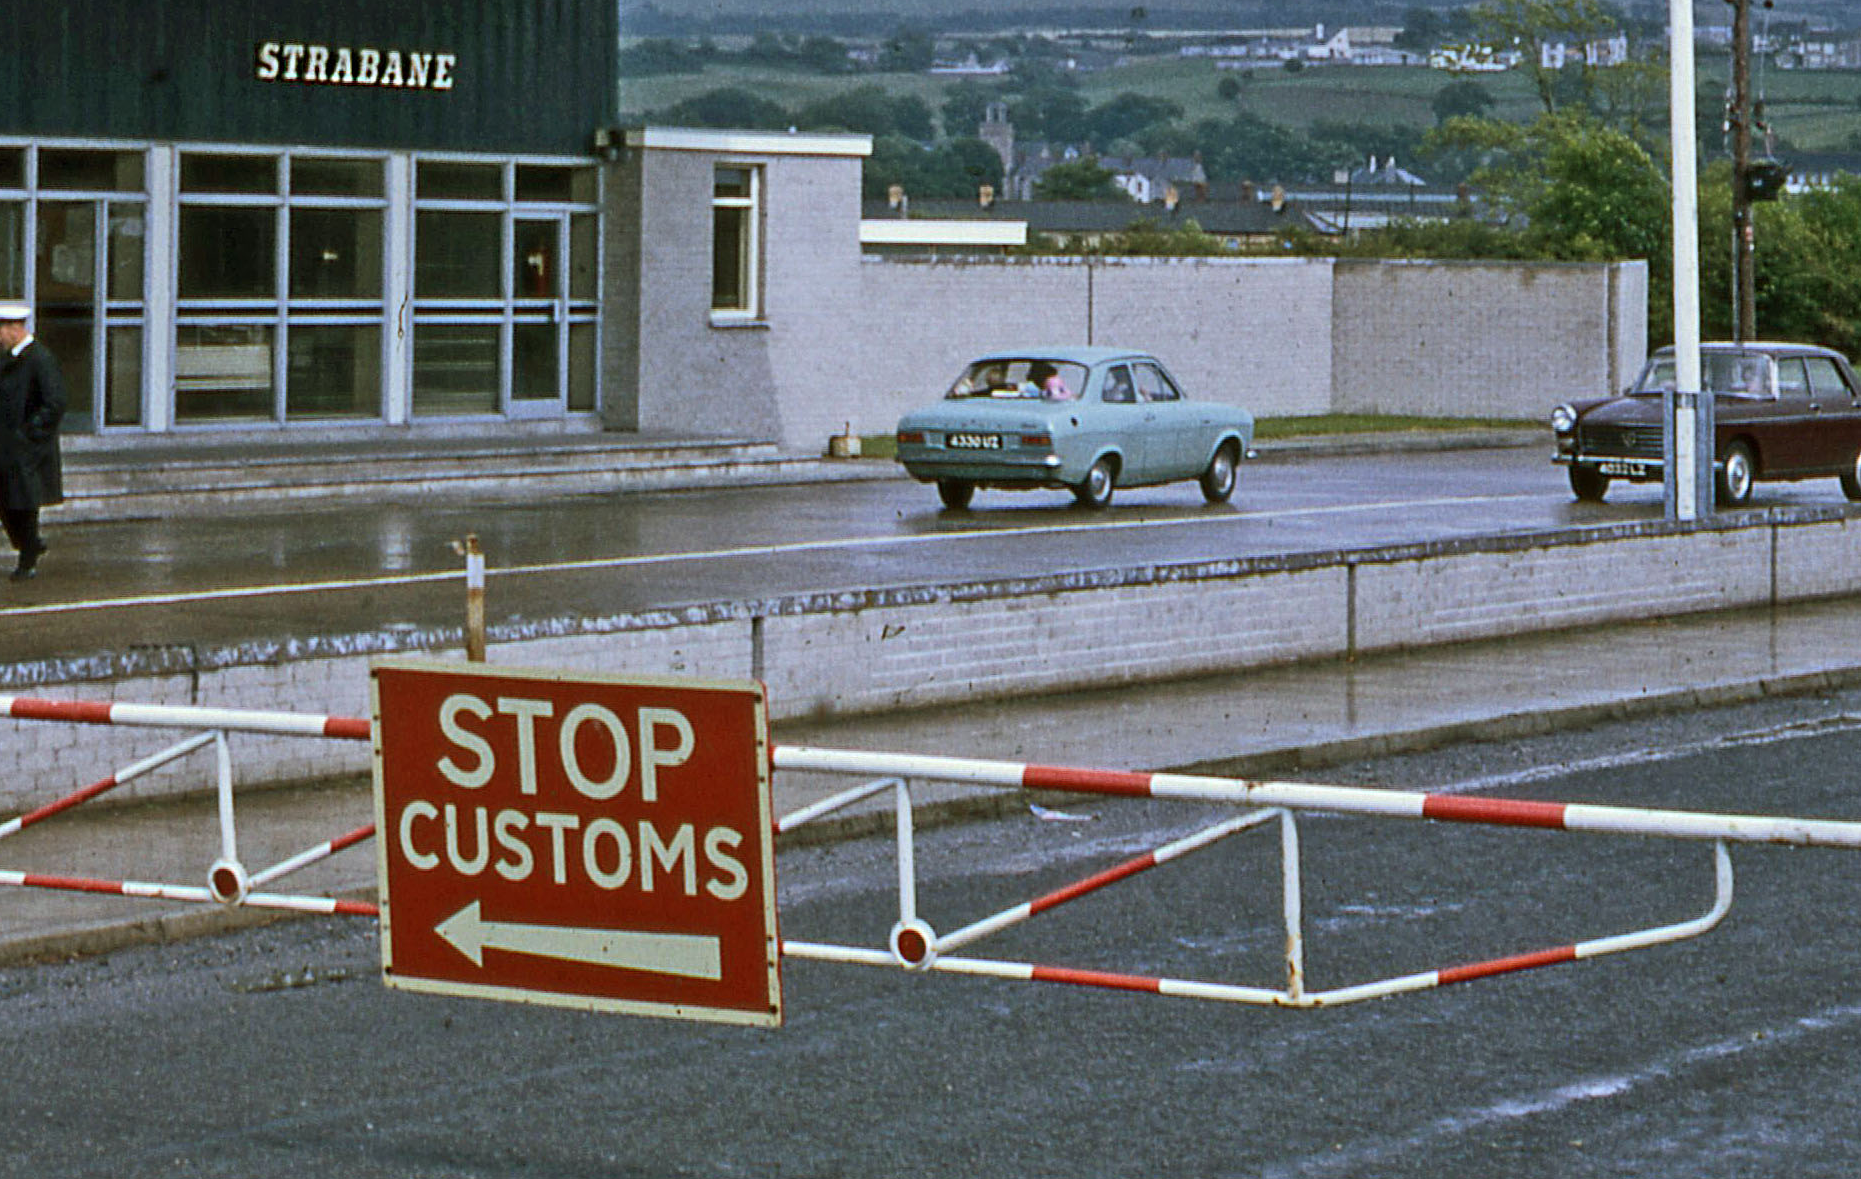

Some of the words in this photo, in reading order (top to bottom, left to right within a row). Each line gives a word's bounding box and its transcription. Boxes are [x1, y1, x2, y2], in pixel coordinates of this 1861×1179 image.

[257, 41, 457, 89] STRABANE
[437, 693, 695, 802] STOP
[399, 799, 749, 901] CUSTOMS
